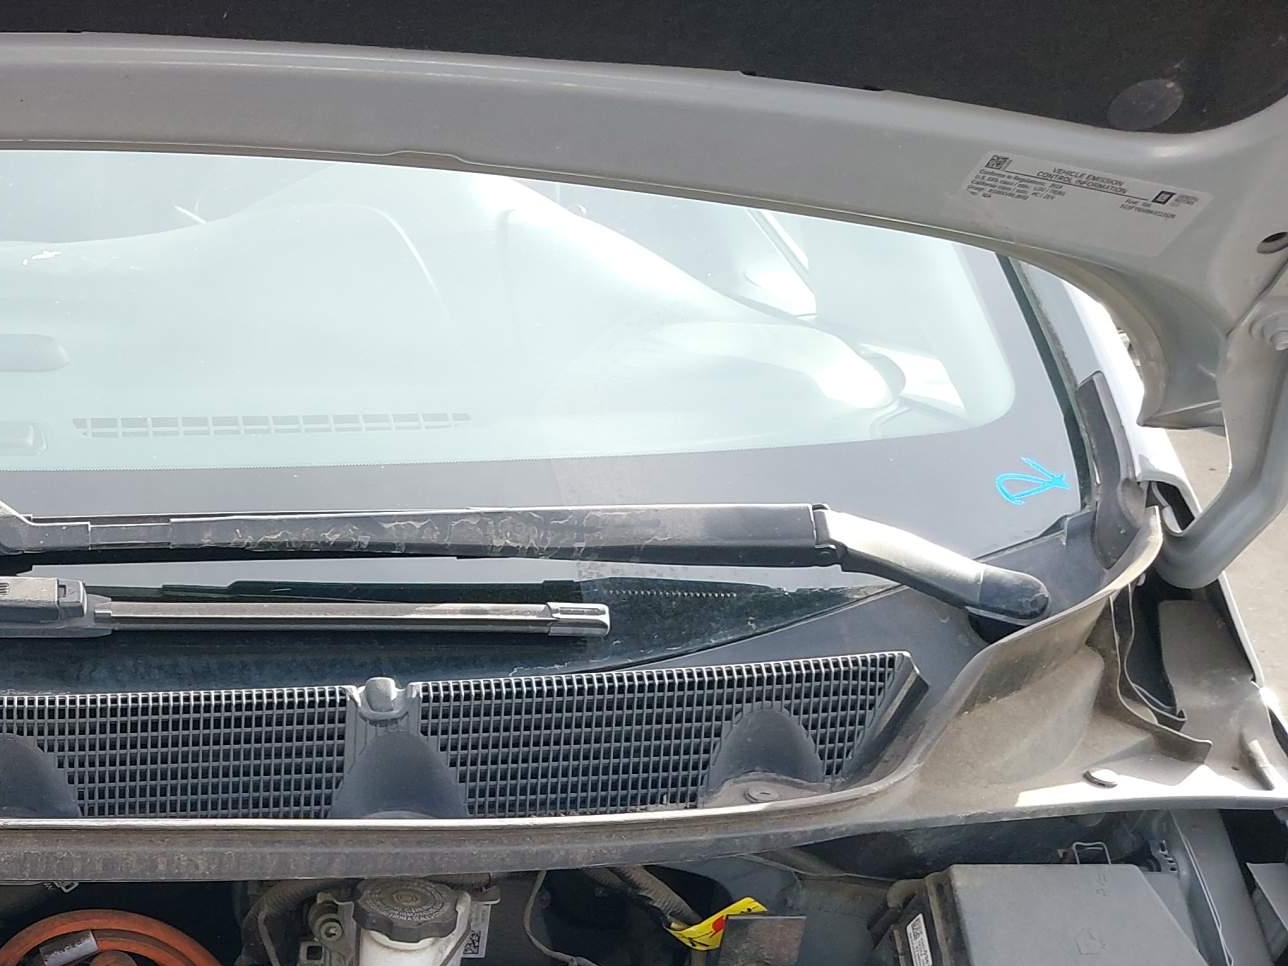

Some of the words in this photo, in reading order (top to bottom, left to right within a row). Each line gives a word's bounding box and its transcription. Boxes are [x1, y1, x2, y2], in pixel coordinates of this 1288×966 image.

[1037, 171, 1074, 184] CONTROL
[1053, 167, 1085, 178] VEHICLE
[1086, 172, 1124, 186] EMISSION
